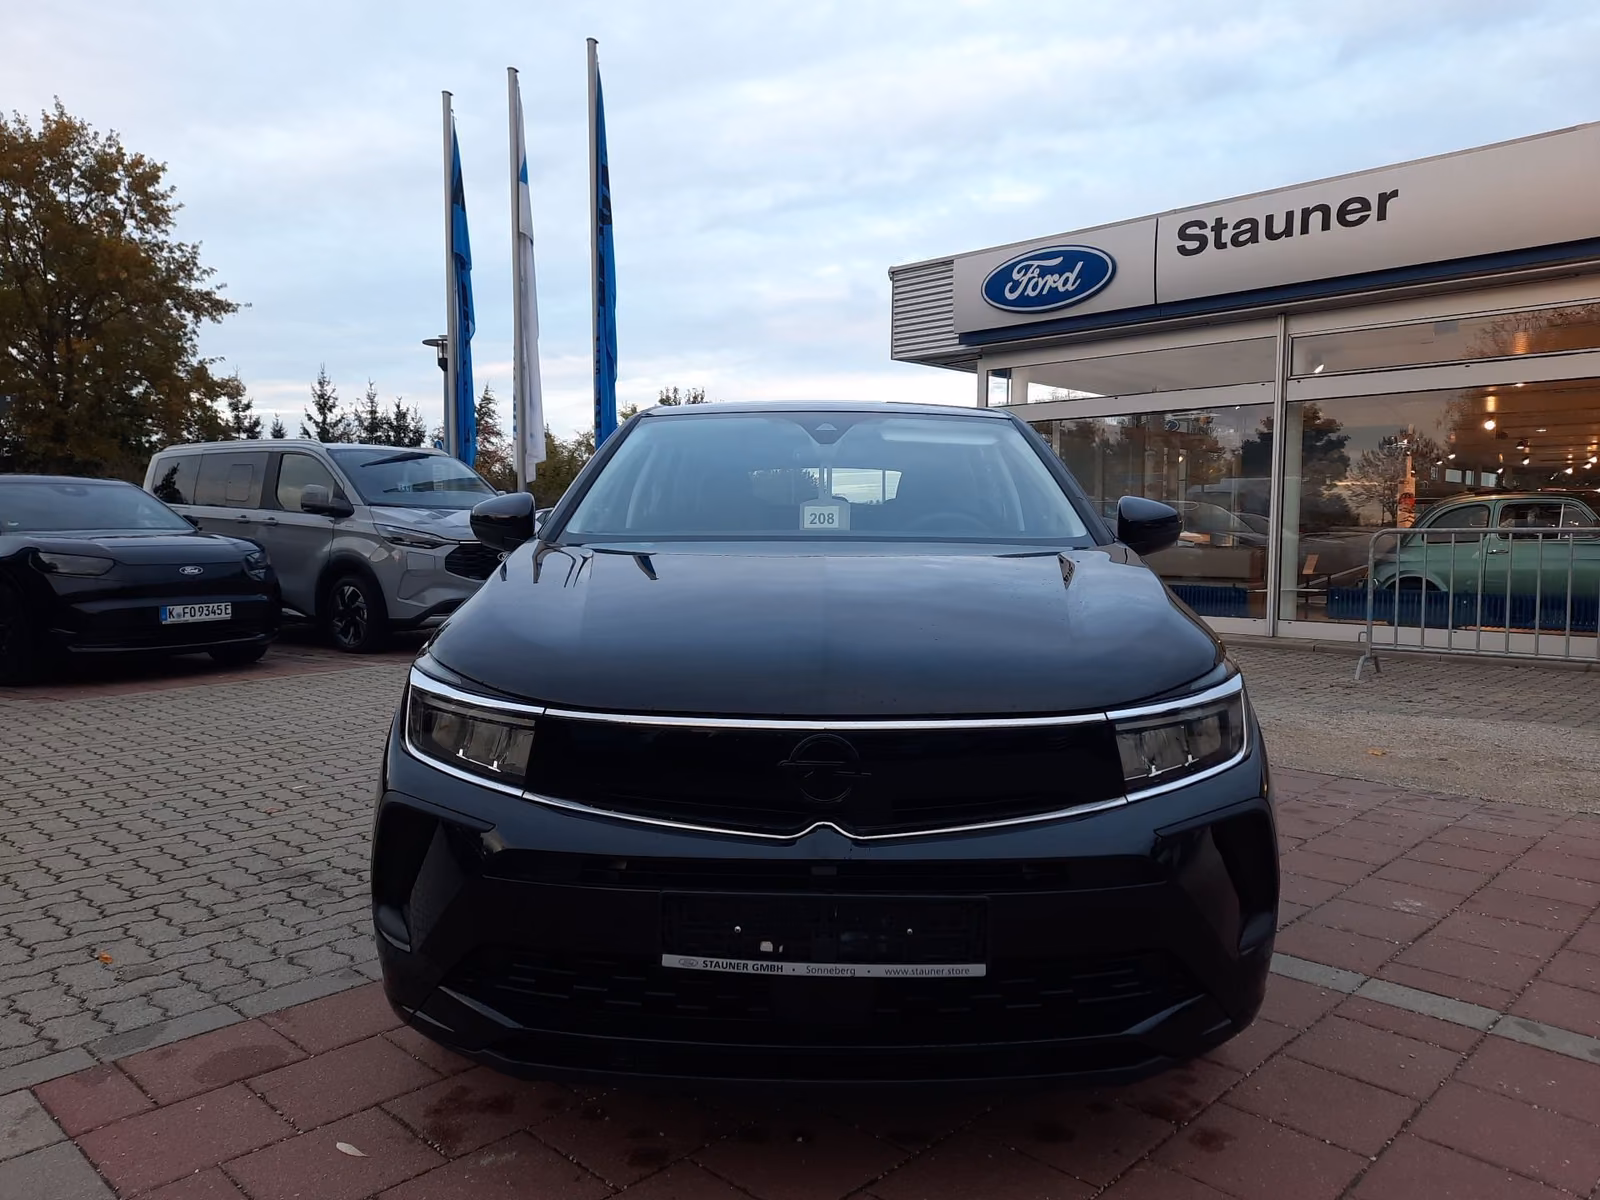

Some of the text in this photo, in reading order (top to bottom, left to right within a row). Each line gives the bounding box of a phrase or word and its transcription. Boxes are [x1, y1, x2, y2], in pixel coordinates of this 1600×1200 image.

[1176, 188, 1399, 257] Stauner
[1004, 256, 1084, 300] Ford
[809, 512, 835, 525] 208
[168, 607, 175, 619] K
[702, 959, 749, 971] STAUNER
[752, 963, 784, 973] GMBH
[806, 965, 856, 976] Sonneberg
[884, 966, 970, 976] www.stauner.store
